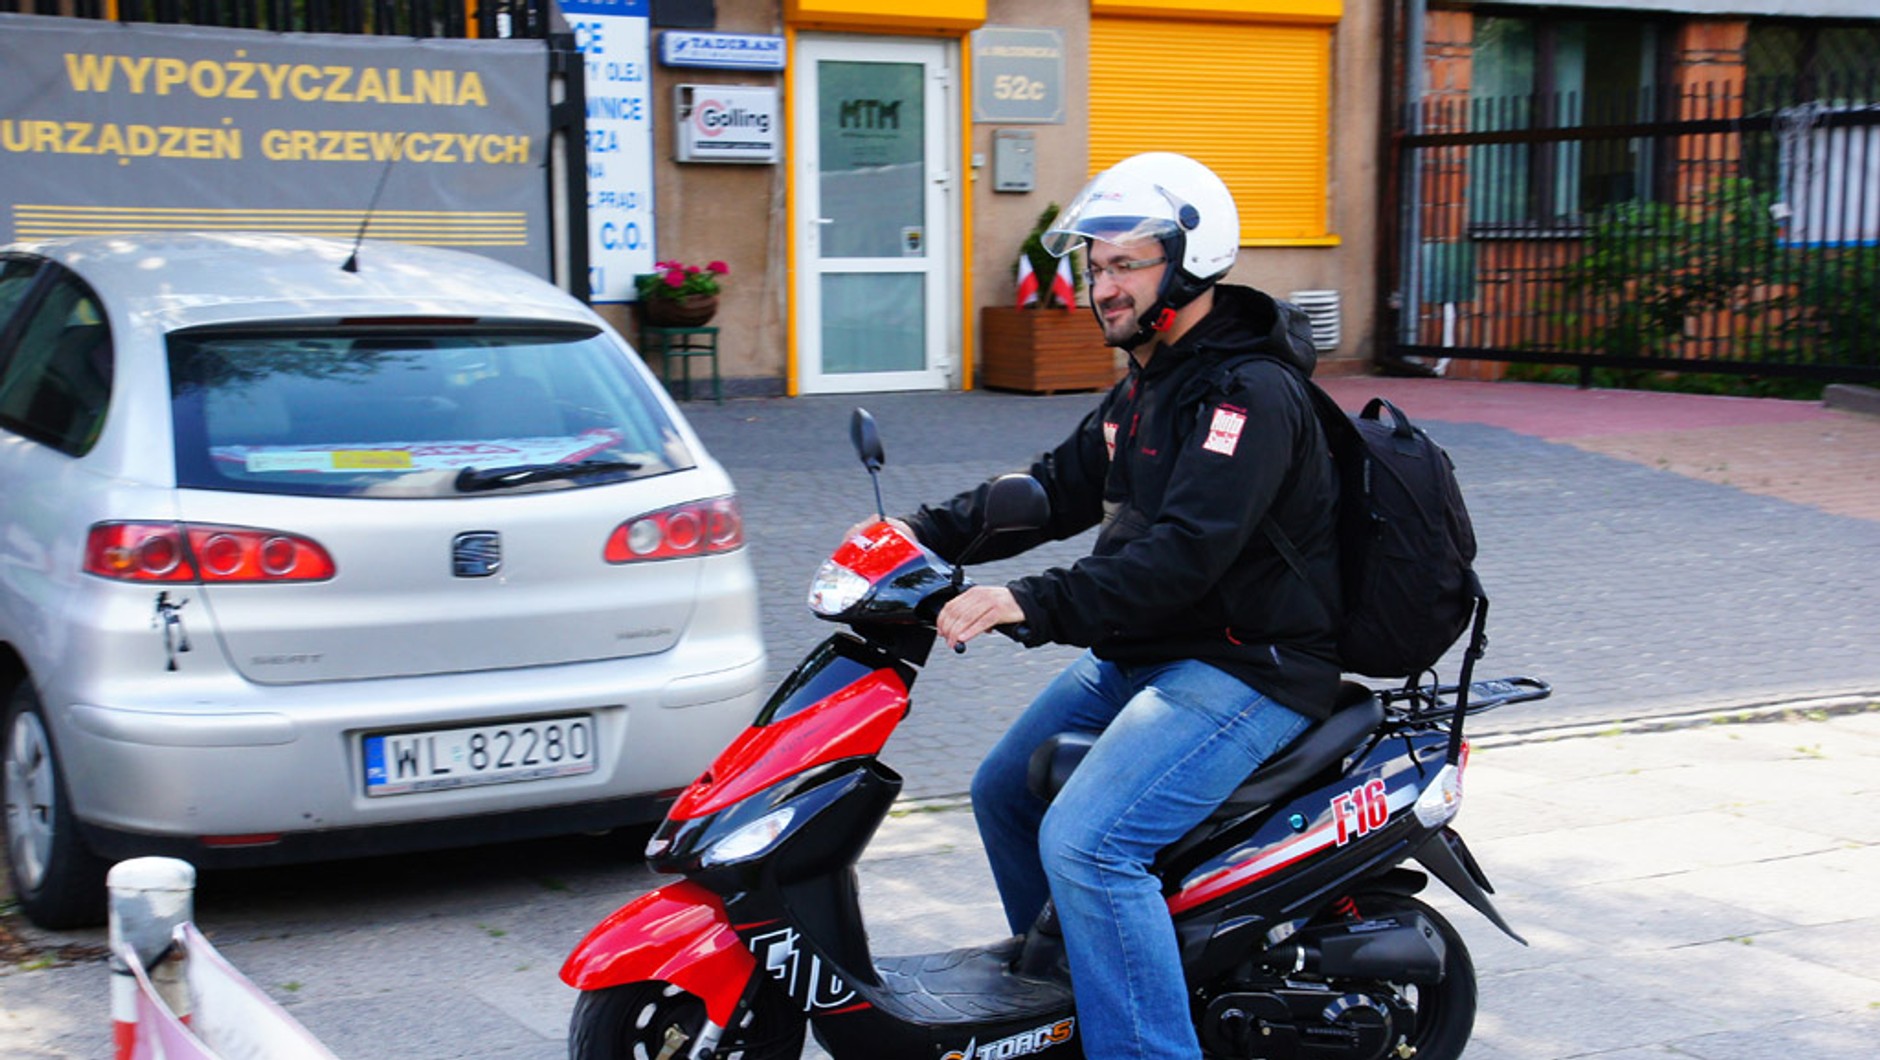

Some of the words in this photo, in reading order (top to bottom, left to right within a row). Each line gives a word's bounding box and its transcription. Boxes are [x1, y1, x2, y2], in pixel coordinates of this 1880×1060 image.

[64, 49, 488, 107] WYPOŻYCZALNIA
[993, 75, 1046, 101] 52c
[0, 117, 243, 167] URZĄDZEŃ
[261, 128, 530, 164] GRZEWCZYCH
[393, 736, 451, 779] WL
[468, 722, 589, 771] 82280
[1330, 778, 1389, 848] F16
